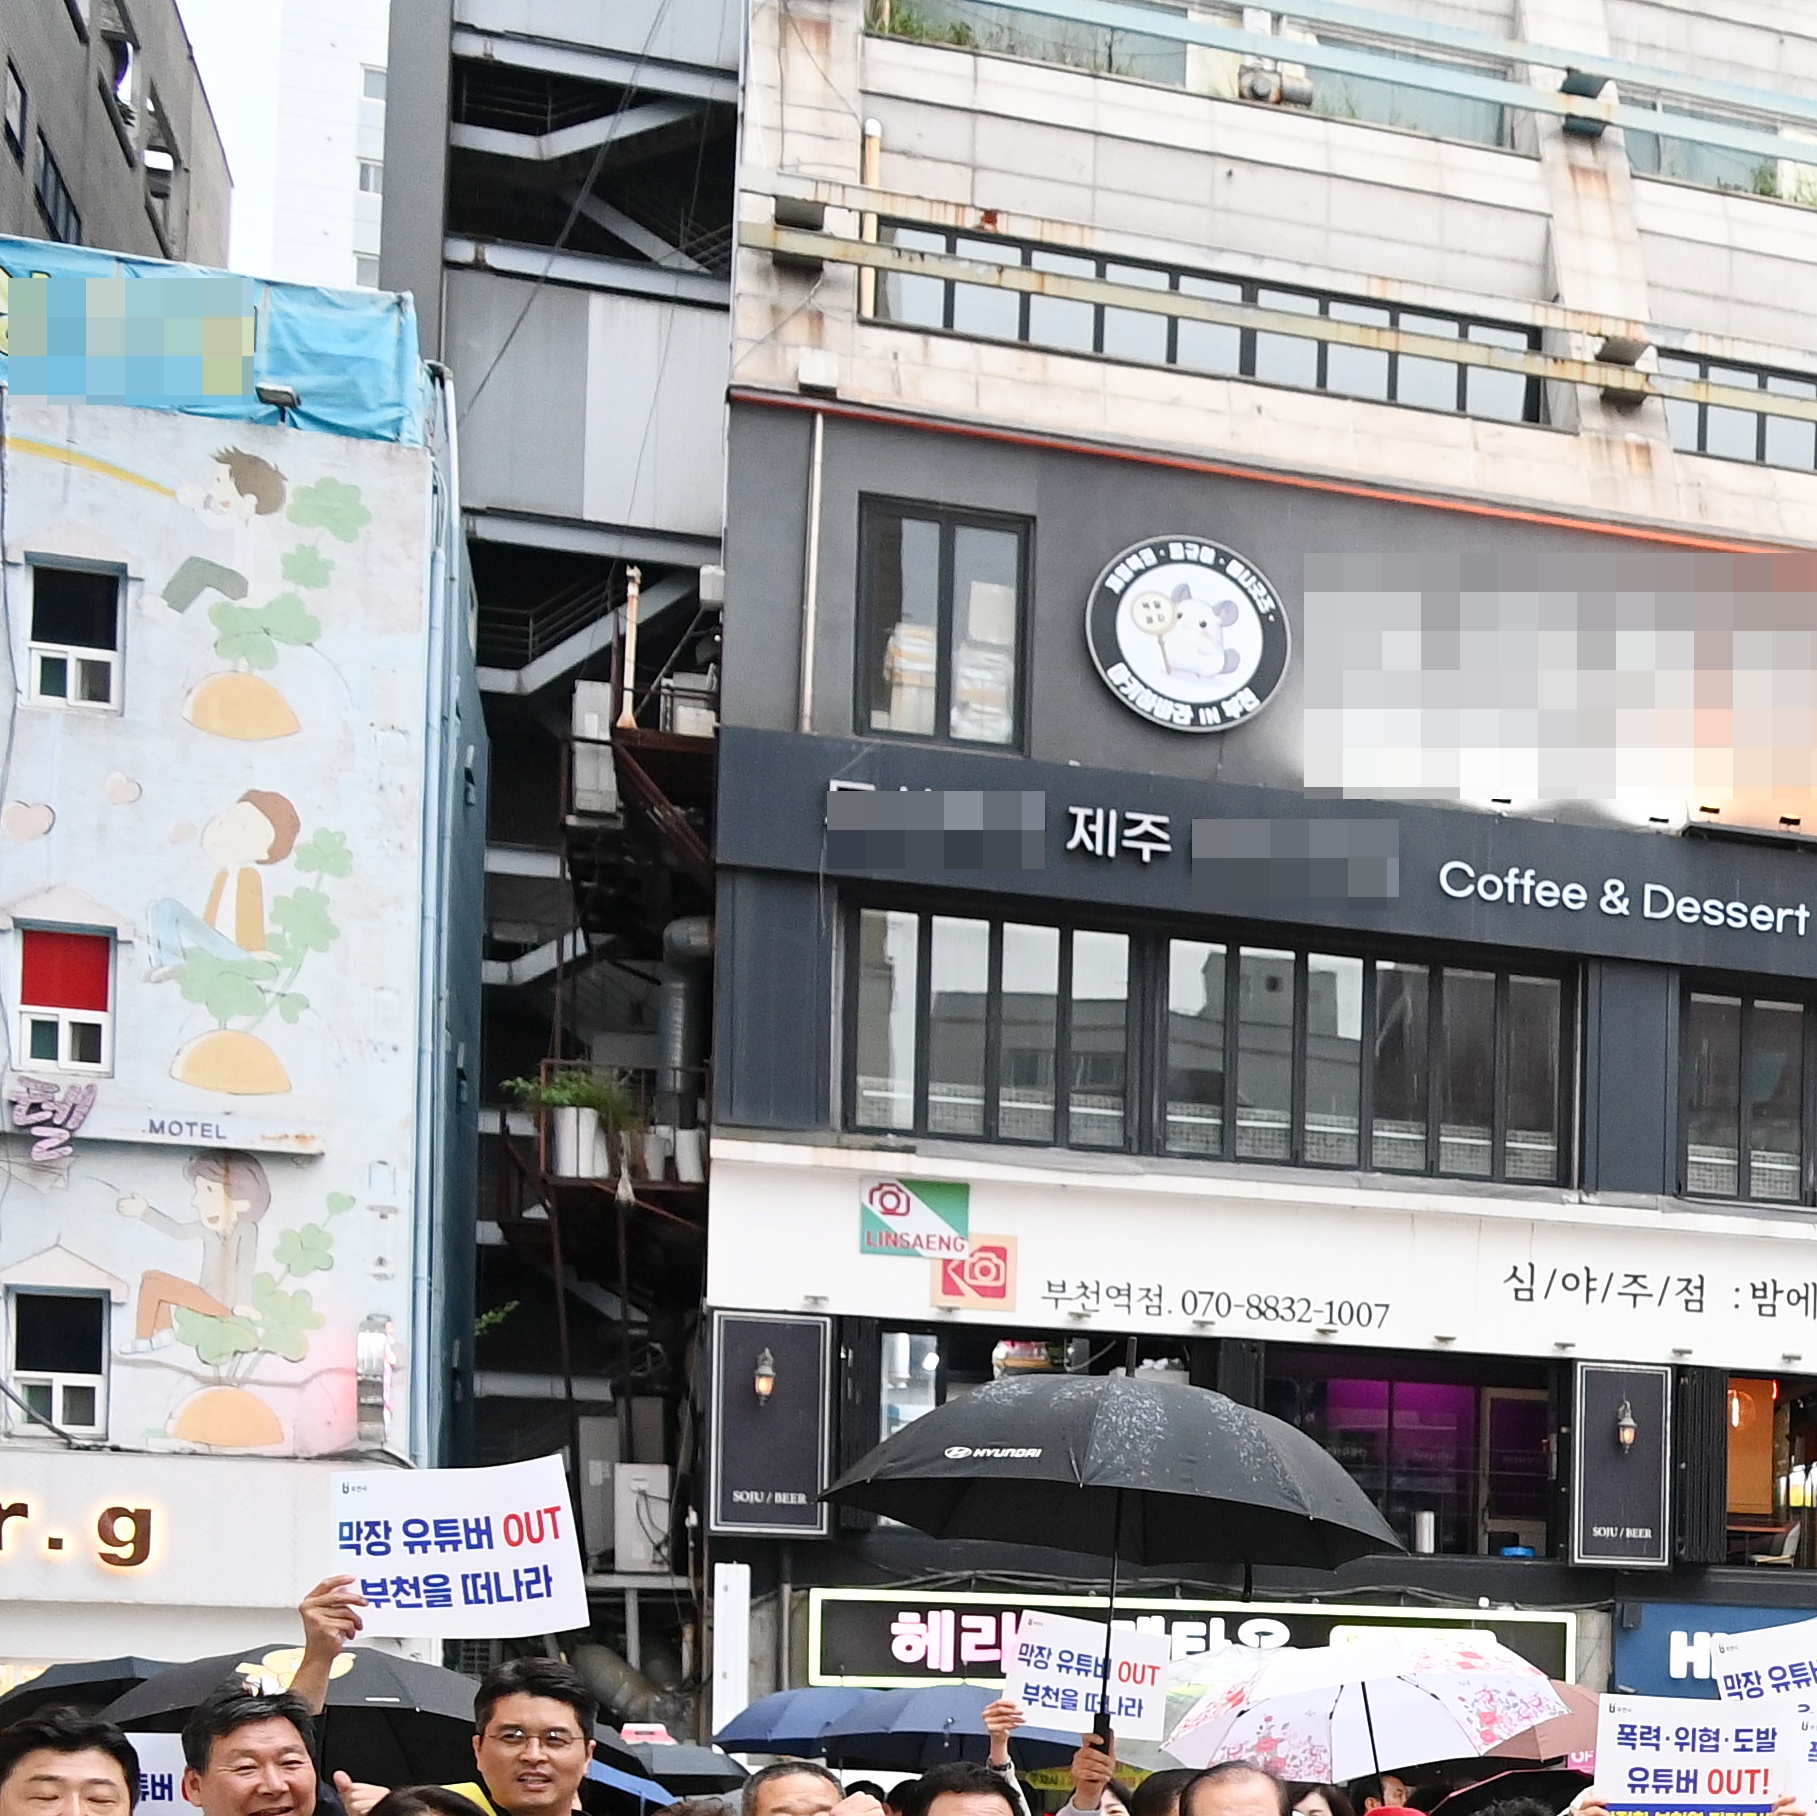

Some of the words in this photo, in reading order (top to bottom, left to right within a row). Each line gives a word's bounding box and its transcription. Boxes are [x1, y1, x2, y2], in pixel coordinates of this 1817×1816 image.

[1066, 805, 1172, 864] 제주
[1439, 859, 1589, 912] Coffee
[1599, 877, 1631, 918] &
[1642, 883, 1812, 937] Dessert
[148, 1117, 228, 1141] MOTEL
[866, 1229, 969, 1254] LINSAENG
[1181, 1289, 1391, 1331] 070-8832-1007
[973, 1446, 1043, 1461] HYUNDAI
[732, 1489, 765, 1503] SOJU
[774, 1491, 808, 1505] BEER
[339, 1520, 392, 1556] 막장
[403, 1516, 493, 1554] 유튜버
[504, 1506, 561, 1547] OUT
[1591, 1526, 1619, 1539] SOJU
[1625, 1527, 1653, 1541] BEER
[361, 1574, 453, 1608] 부천을
[461, 1565, 552, 1605] 떠나라
[1020, 1644, 1051, 1669] 막장
[1119, 1661, 1161, 1685] OUT
